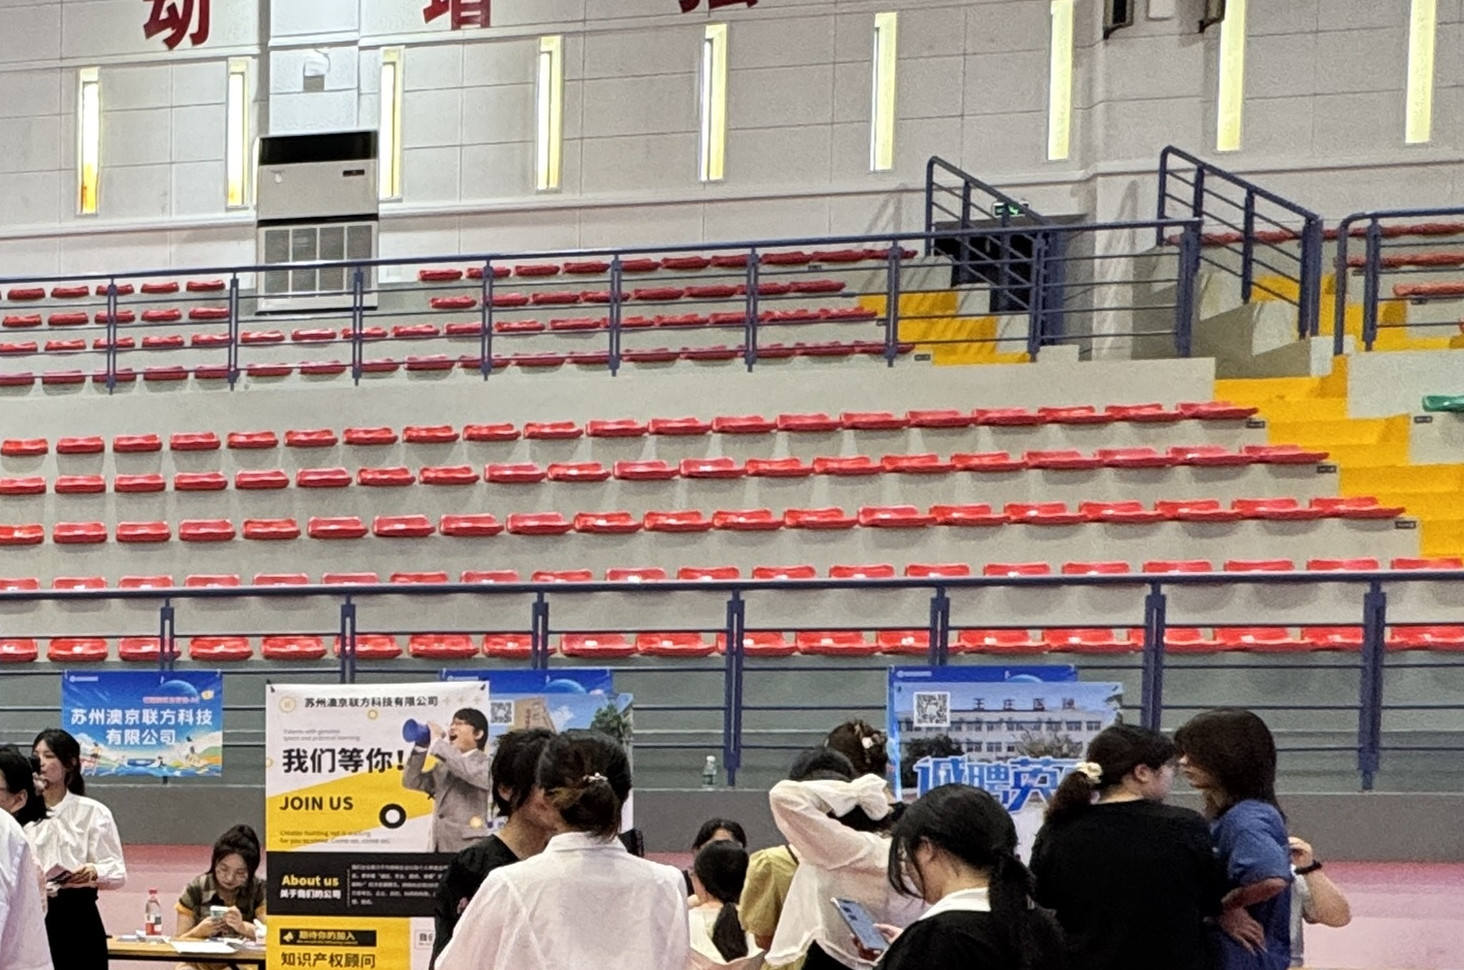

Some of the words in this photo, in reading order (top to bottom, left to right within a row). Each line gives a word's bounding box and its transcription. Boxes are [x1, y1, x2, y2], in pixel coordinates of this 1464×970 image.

[304, 696, 439, 709] 苏州澳京联方科技有限公司
[70, 708, 213, 726] 苏州澳京联方科技
[105, 729, 176, 745] 有限公司
[279, 796, 324, 811] JOIN
[329, 796, 354, 811] US
[281, 873, 321, 887] About
[323, 876, 340, 887] us
[281, 952, 376, 969] 知识产权顾问
